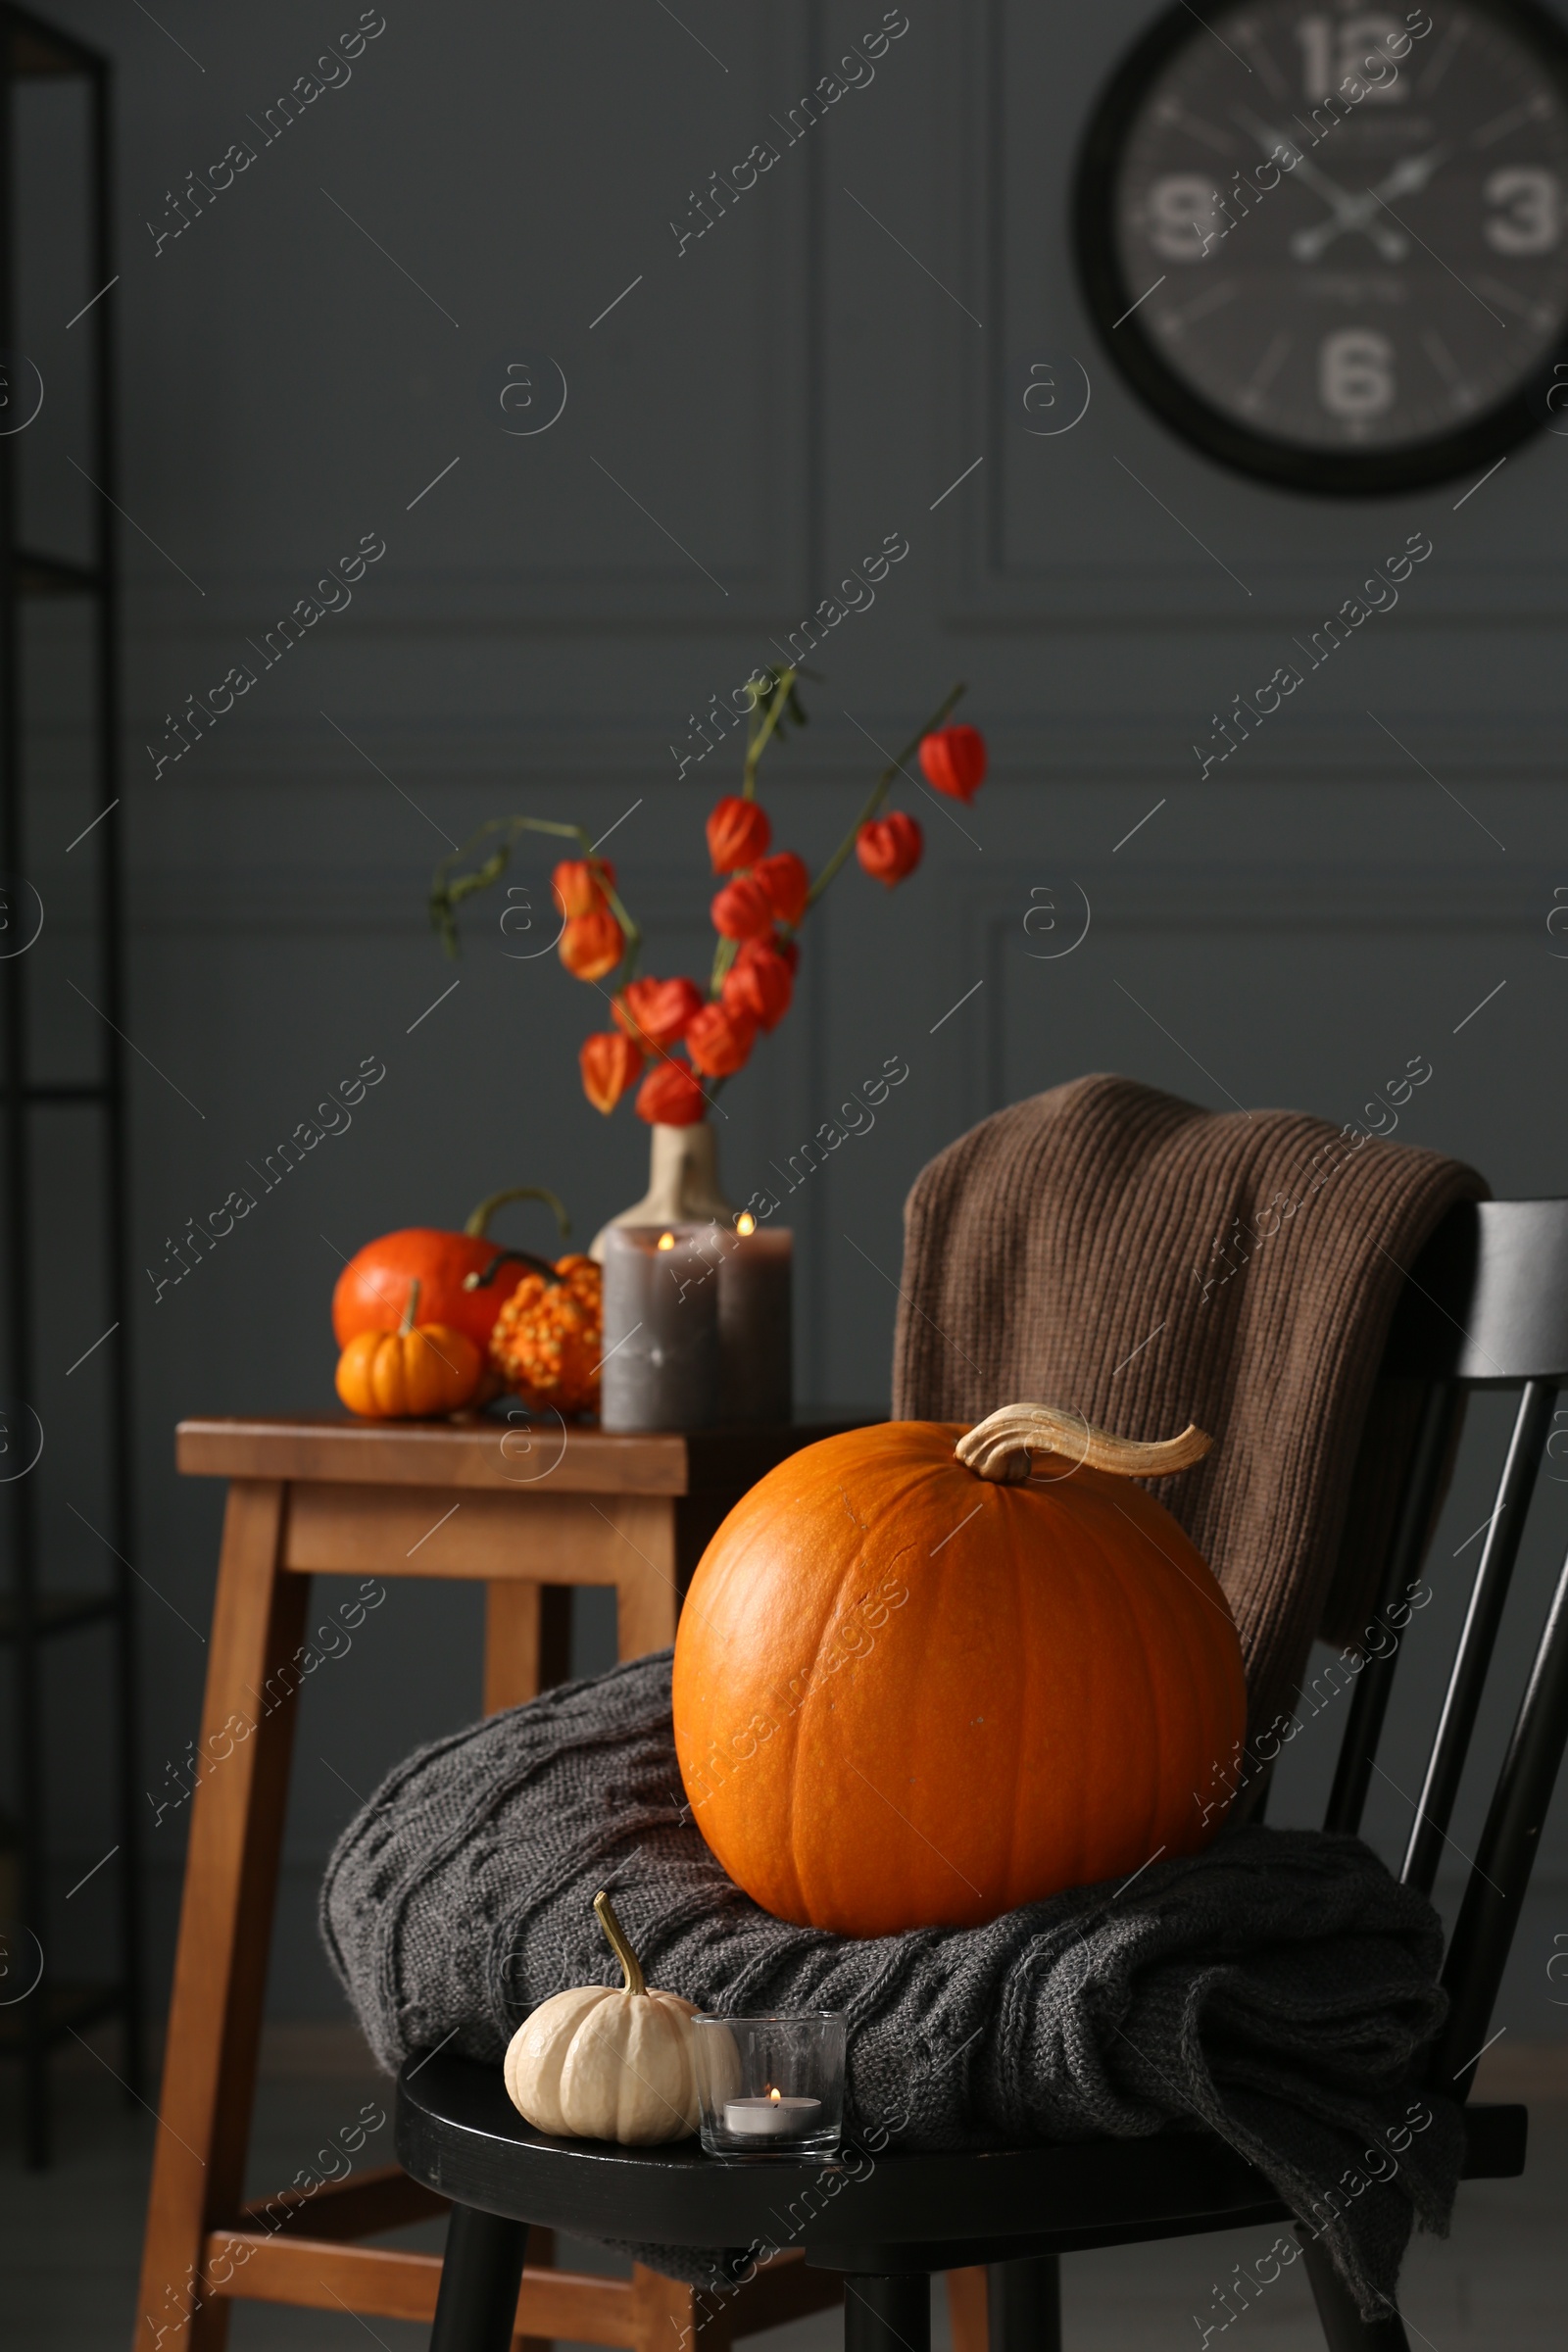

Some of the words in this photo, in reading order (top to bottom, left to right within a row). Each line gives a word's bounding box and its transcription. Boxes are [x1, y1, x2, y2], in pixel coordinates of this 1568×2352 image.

[1297, 14, 1408, 102] 12
[1150, 174, 1220, 261] 9
[1484, 167, 1559, 256] 3
[1320, 329, 1394, 416] 6
